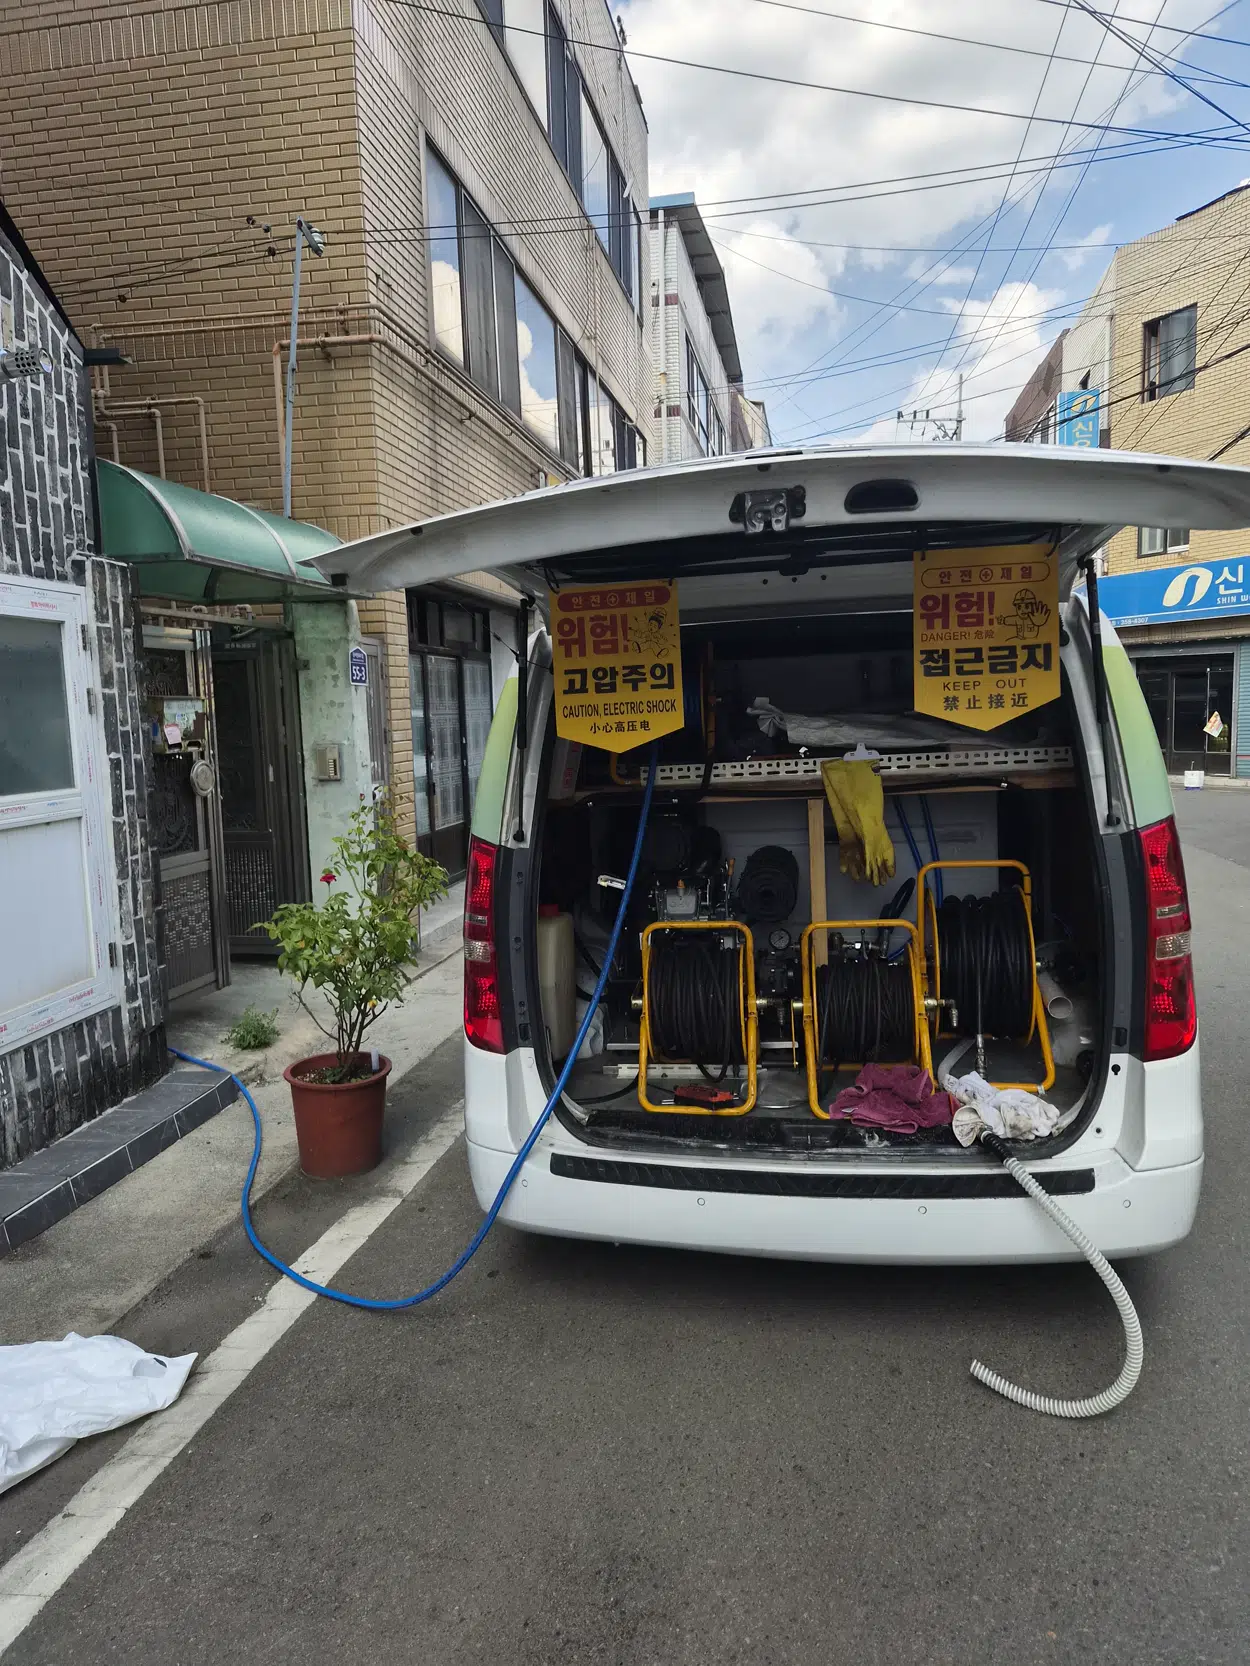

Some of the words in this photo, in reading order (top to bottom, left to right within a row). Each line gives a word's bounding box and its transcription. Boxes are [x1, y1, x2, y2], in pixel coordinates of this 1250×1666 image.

[938, 569, 972, 584] 안전
[1216, 595, 1238, 605] SHIN
[919, 591, 996, 630] 위험!
[557, 614, 629, 658] 위험!
[920, 631, 971, 642] DANGER!
[920, 643, 1052, 677] 접근금지
[353, 666, 365, 680] 55-3
[563, 663, 675, 695] 고압주의
[942, 680, 981, 692] KEEP
[995, 678, 1027, 689] OUT
[603, 702, 644, 716] ELECTRIC
[646, 699, 677, 713] SHOCK
[942, 692, 1029, 712] 禁止接近
[589, 720, 651, 734] 小心高压电
